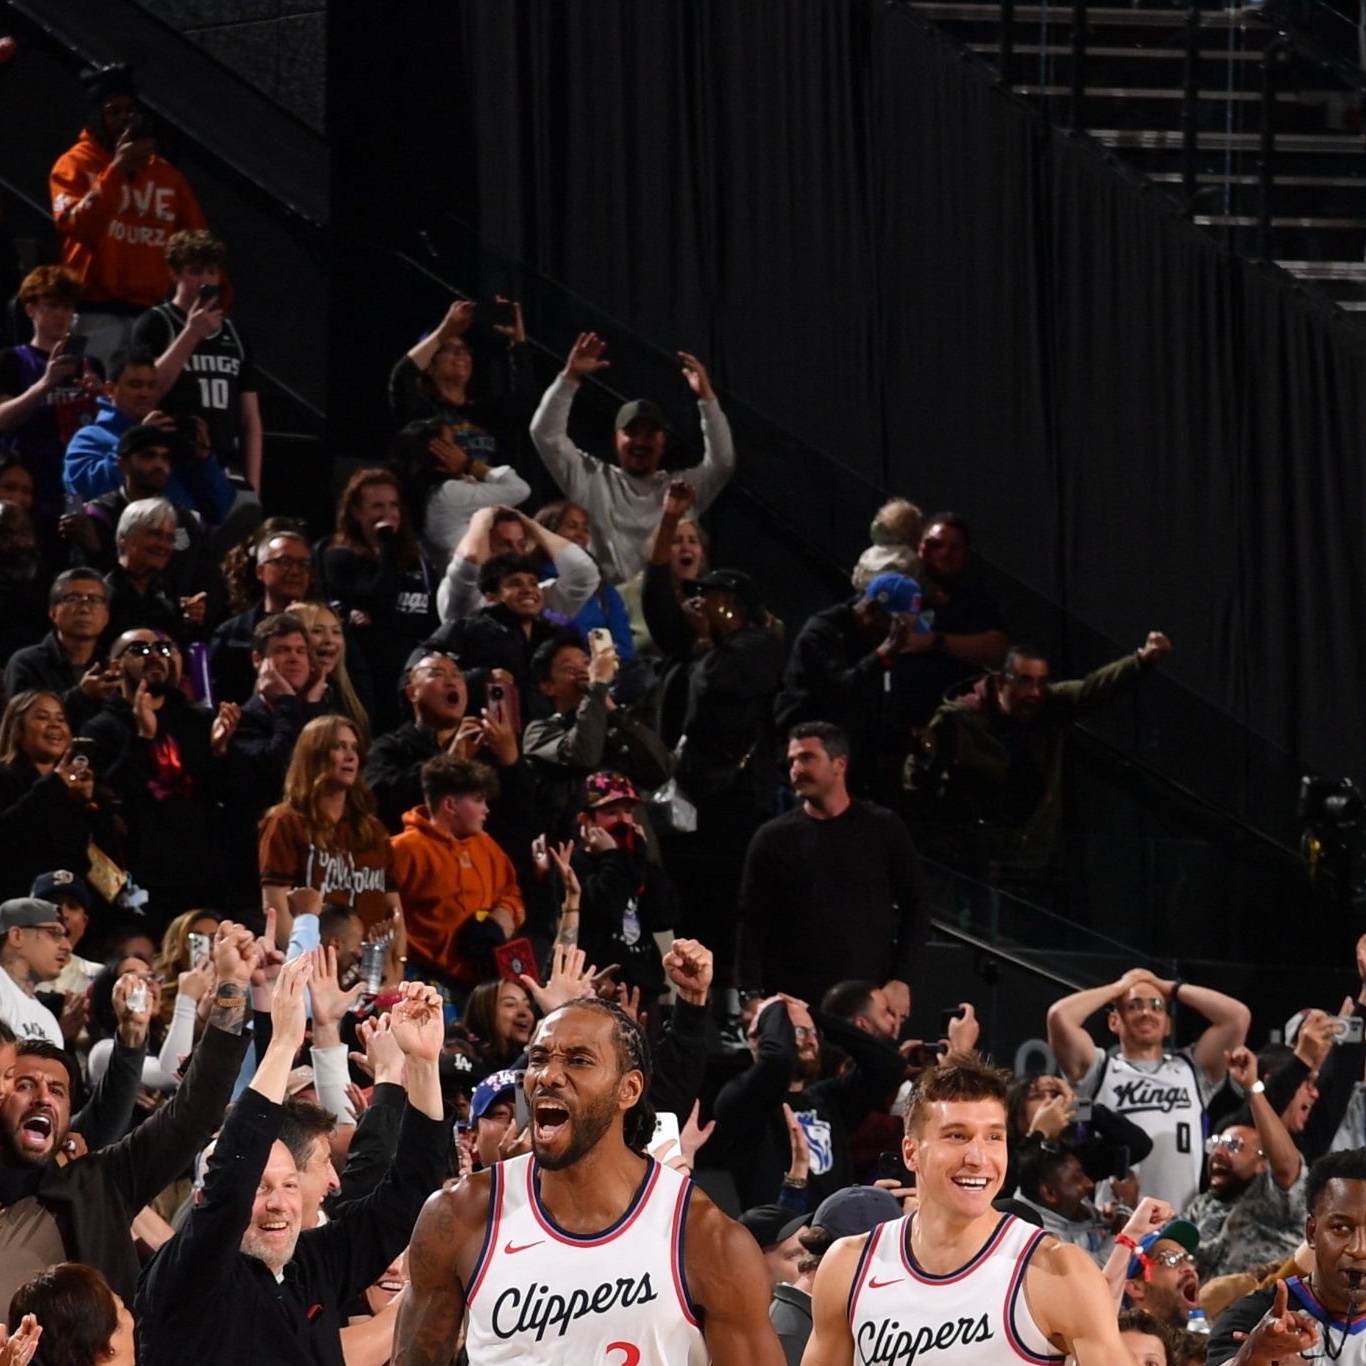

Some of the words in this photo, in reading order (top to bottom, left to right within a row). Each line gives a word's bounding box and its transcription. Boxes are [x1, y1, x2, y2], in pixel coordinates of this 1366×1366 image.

[197, 377, 229, 410] 10
[454, 1052, 473, 1073] LA
[1113, 1079, 1192, 1114] Kings
[1176, 1122, 1191, 1154] 0
[491, 1271, 658, 1342] Clippers
